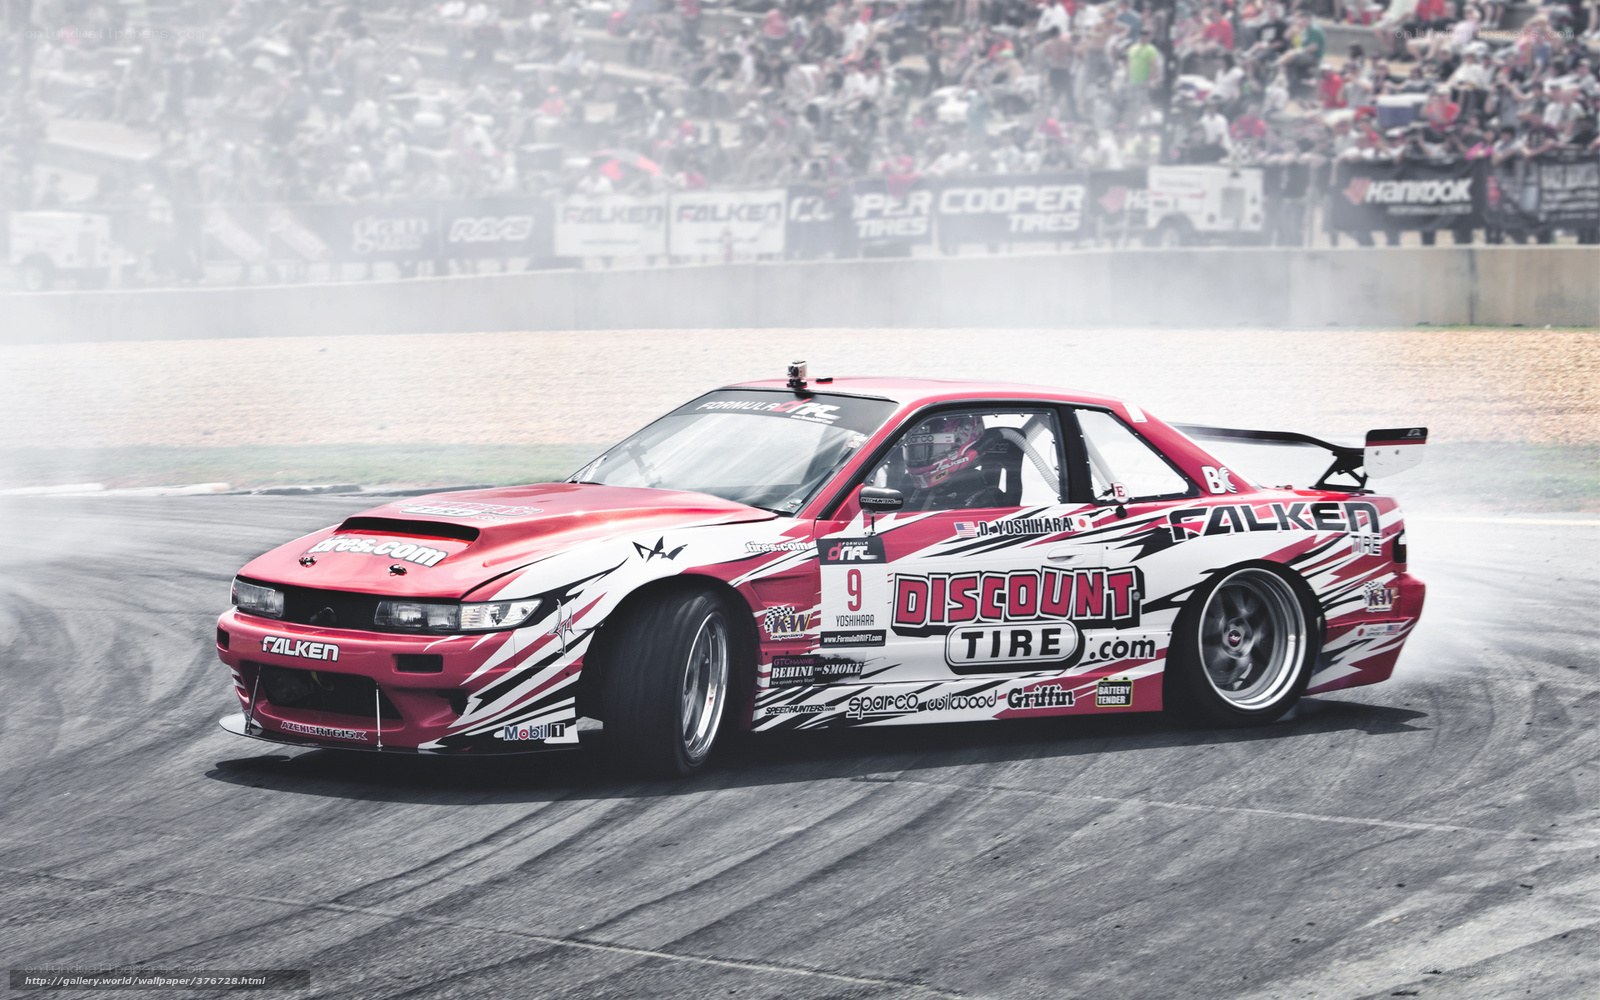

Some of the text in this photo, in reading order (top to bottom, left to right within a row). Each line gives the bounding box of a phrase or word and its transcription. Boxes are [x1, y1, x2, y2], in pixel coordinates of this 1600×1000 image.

[939, 184, 1086, 214] COOPER
[563, 205, 663, 224] FALKEN
[677, 203, 782, 223] FALKEN
[1008, 213, 1082, 233] TIRES
[857, 217, 929, 238] TIRES
[696, 402, 778, 411] FORMULA
[1116, 486, 1125, 498] E
[997, 517, 1072, 535] YOSHIHARA
[1167, 501, 1382, 542] FALKEN
[305, 535, 449, 568] tires.com
[745, 542, 809, 553] tires.com
[847, 568, 861, 612] 9
[893, 567, 1141, 630] DISCOUNT
[772, 614, 812, 634] KW
[835, 614, 875, 627] YOSHIHARA
[261, 635, 340, 662] FALKEN
[960, 628, 1062, 660] TIRE
[1089, 637, 1156, 660] .com
[822, 663, 863, 675] SMOKE
[1007, 685, 1075, 710] Griffin
[1098, 686, 1131, 695] BATTERY
[1098, 696, 1126, 704] TENDER
[765, 704, 836, 715] SPEEDHUNTERS.com
[848, 693, 919, 719] sparco
[927, 690, 998, 712] wilwood
[504, 725, 548, 741] Mobil
